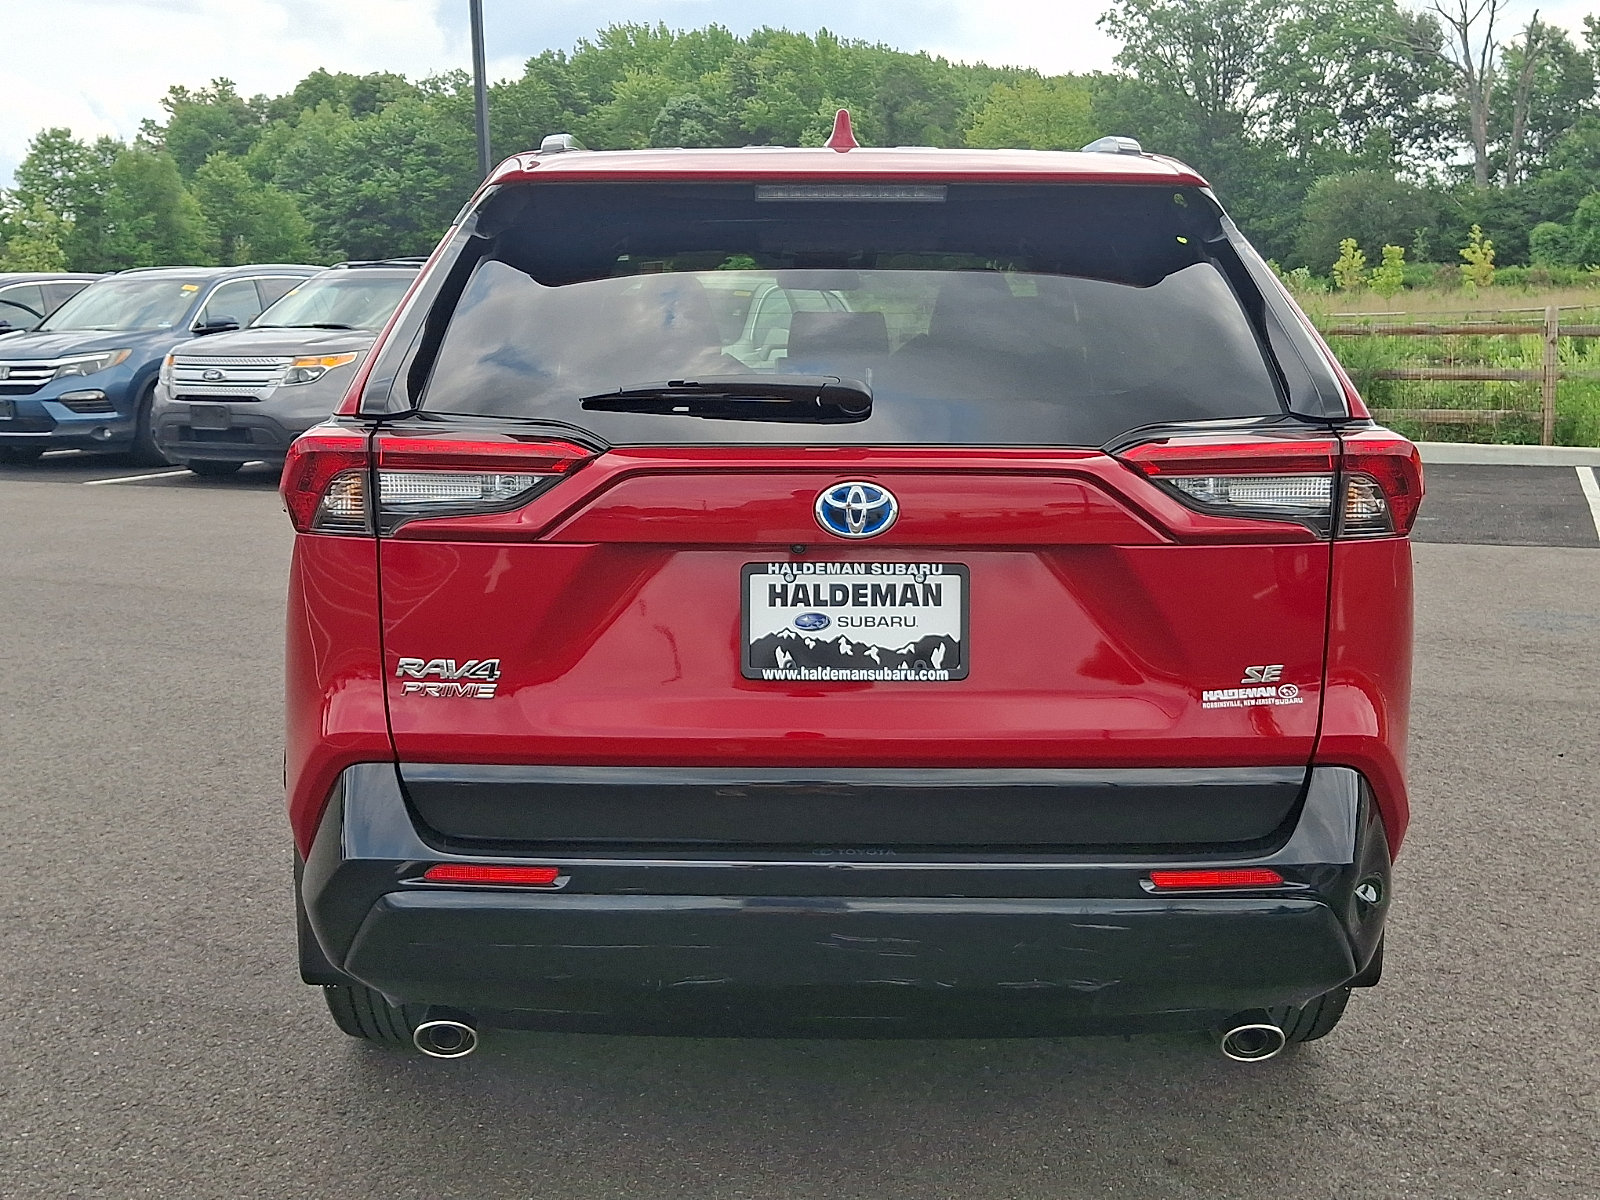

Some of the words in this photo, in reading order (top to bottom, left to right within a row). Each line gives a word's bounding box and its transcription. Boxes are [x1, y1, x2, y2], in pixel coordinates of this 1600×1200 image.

[767, 562, 866, 575] HALDEMAN
[870, 562, 943, 575] SUBARU
[768, 582, 942, 608] HALDEMAN
[837, 615, 916, 628] SUBARU
[395, 657, 501, 681] RAV4
[762, 666, 949, 681] www.haldemansubaru.com
[1240, 664, 1284, 684] SE
[400, 681, 498, 698] PRIME
[1202, 686, 1277, 701] HALDEMAN
[838, 847, 897, 856] TOYOTA
